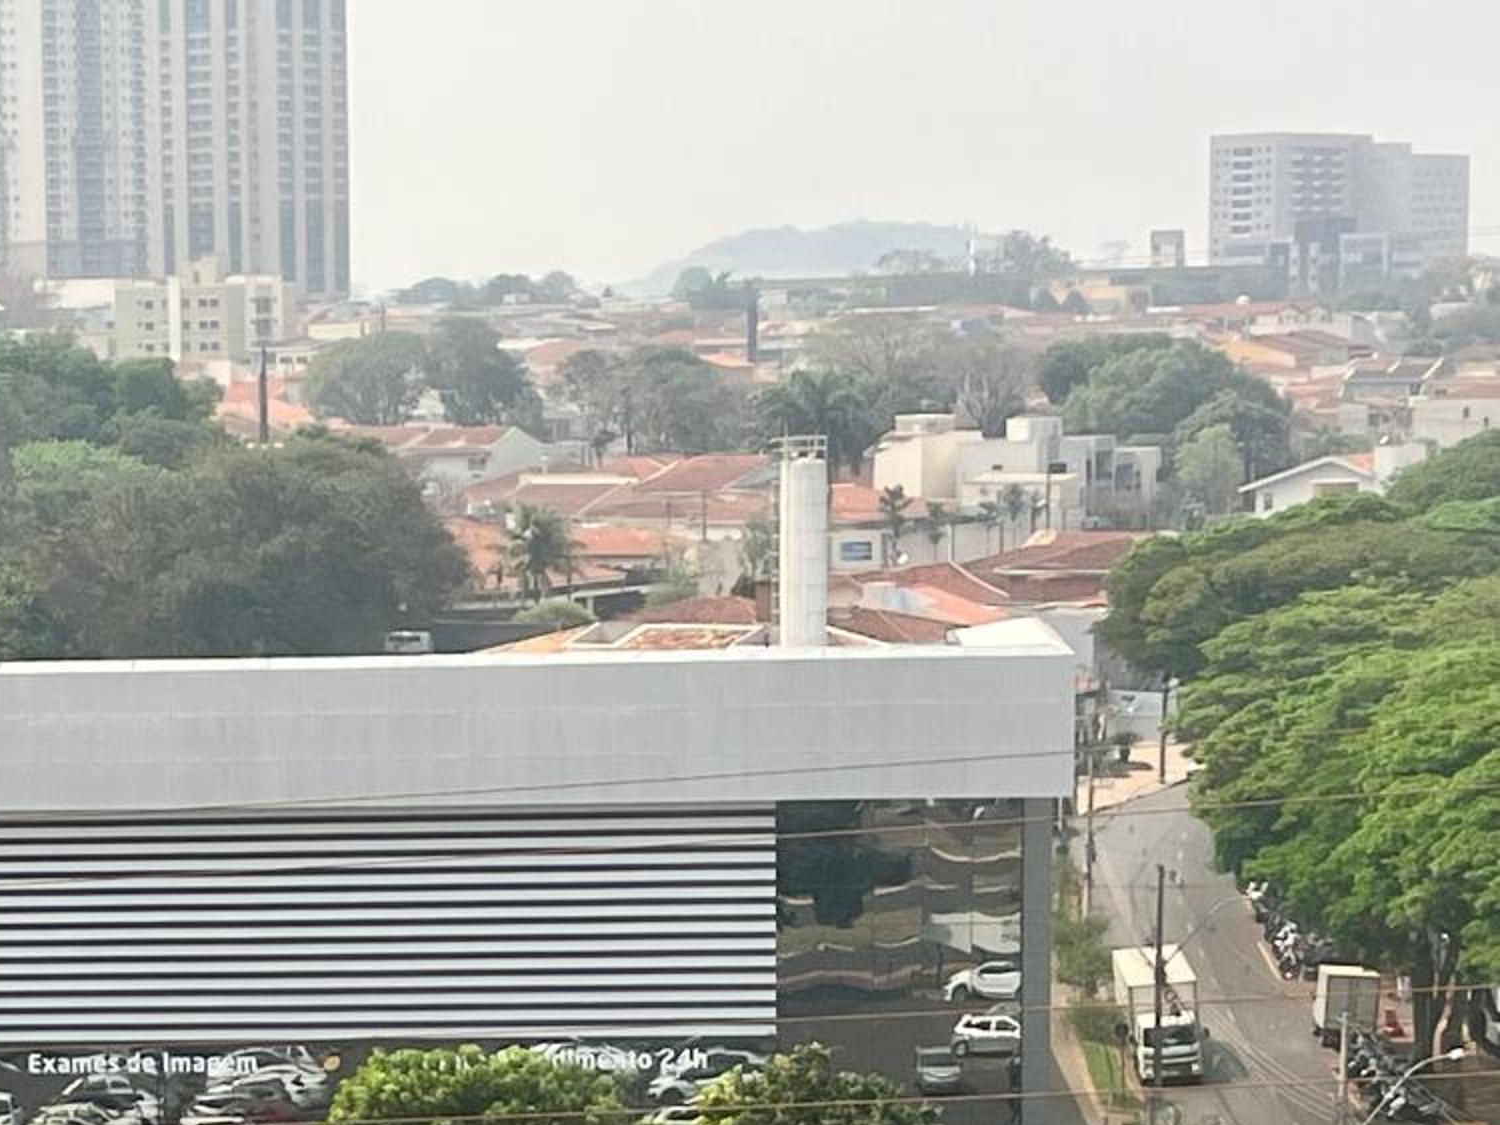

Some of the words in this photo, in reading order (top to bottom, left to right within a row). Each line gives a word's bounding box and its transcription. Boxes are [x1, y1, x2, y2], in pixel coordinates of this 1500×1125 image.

[27, 1053, 122, 1074] Exames
[129, 1052, 157, 1074] de
[659, 1048, 707, 1070] 24h
